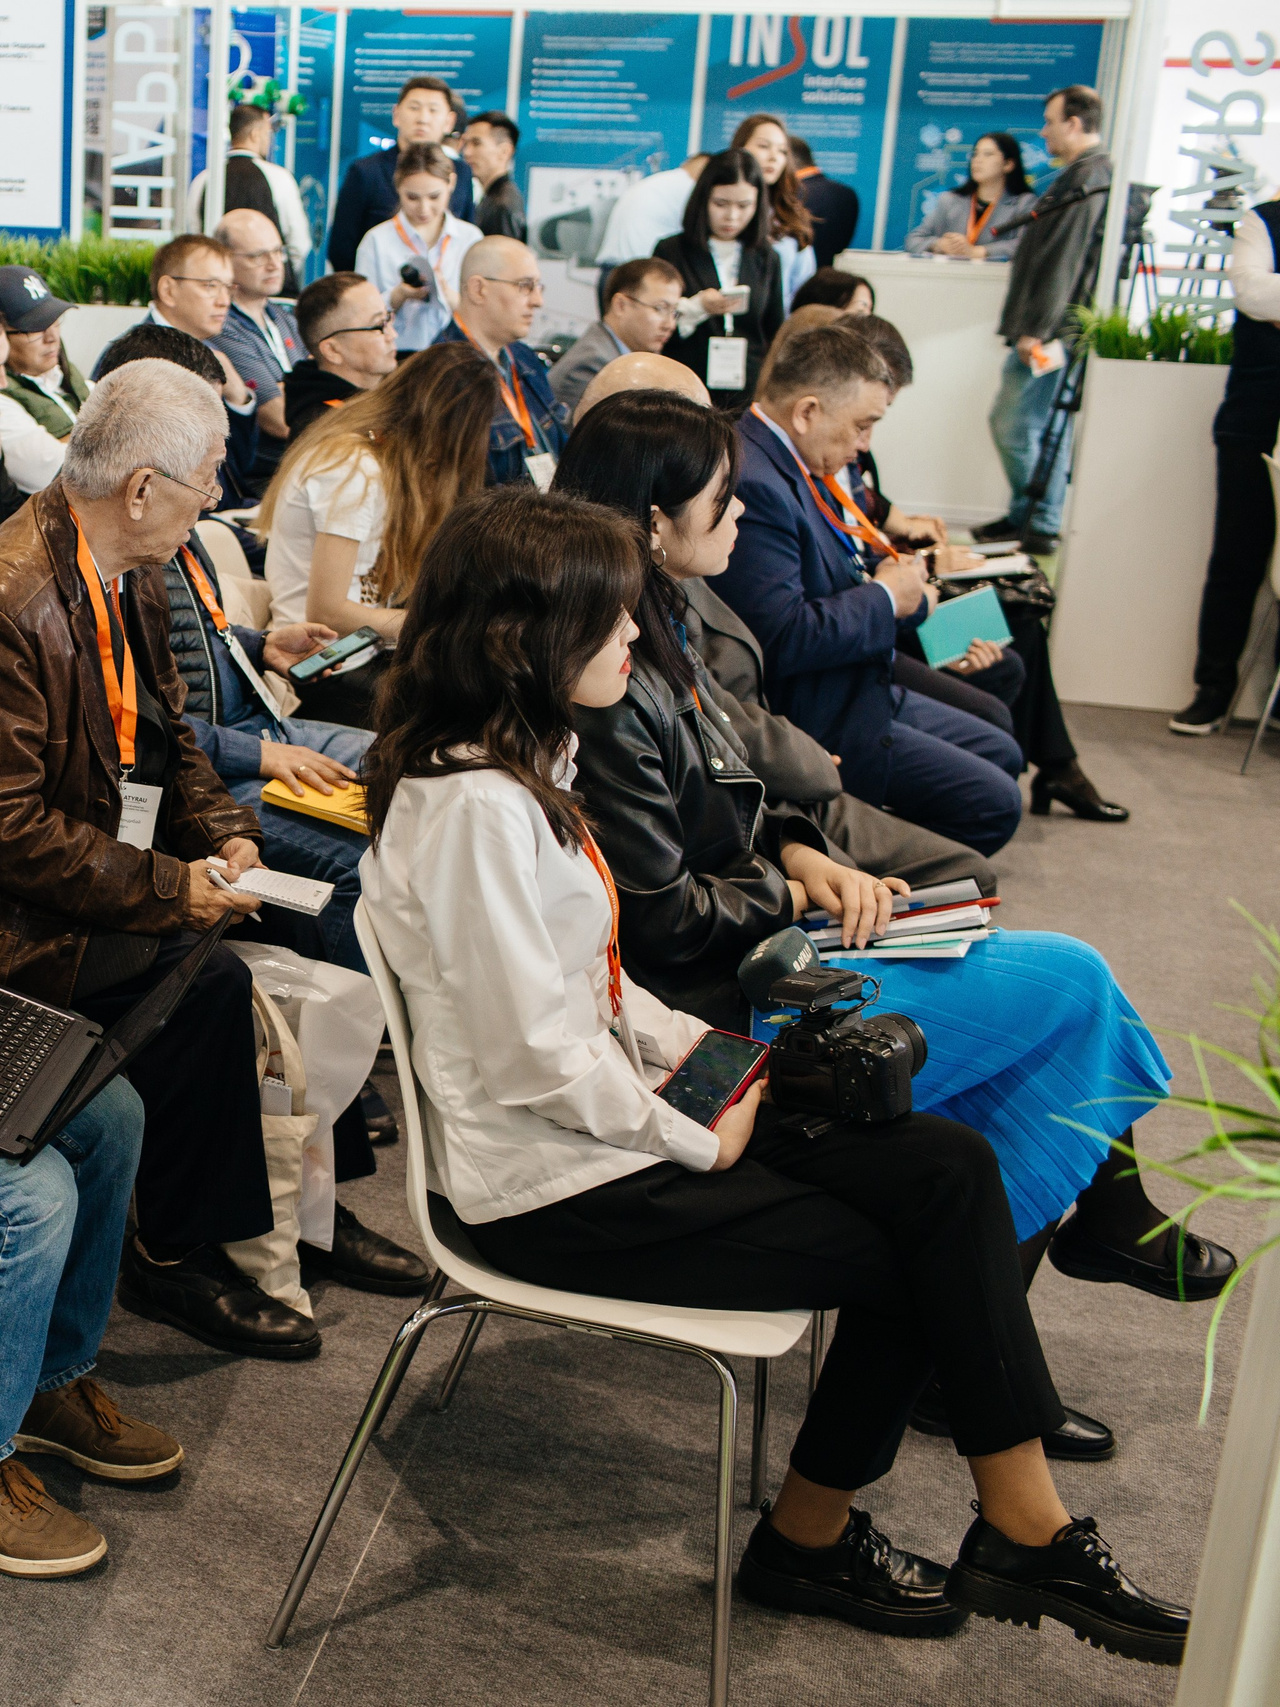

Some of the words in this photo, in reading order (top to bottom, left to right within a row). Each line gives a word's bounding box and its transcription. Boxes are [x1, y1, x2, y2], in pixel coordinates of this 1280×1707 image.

[803, 73, 867, 89] interface
[801, 90, 865, 104] solutions
[23, 275, 48, 300] NY
[123, 794, 148, 804] ATYRAU
